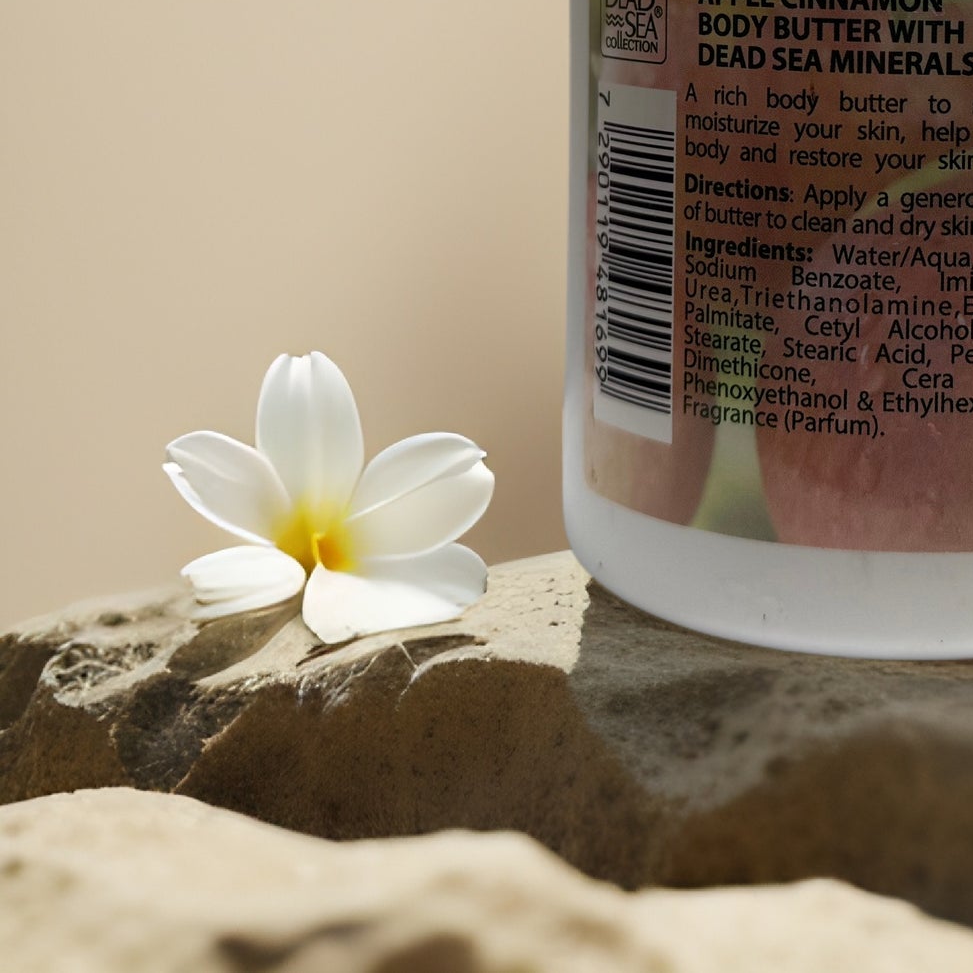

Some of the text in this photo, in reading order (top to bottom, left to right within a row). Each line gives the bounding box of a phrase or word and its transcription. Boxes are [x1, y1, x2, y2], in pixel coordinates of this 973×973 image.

[698, 12, 965, 45] BODY BUTTER WITH
[698, 43, 766, 70] DEAD
[772, 47, 823, 73] SEA
[685, 82, 698, 103] A
[714, 85, 748, 107] rich
[766, 87, 819, 116] body
[839, 90, 908, 113] butter
[928, 95, 951, 114] to
[685, 112, 780, 136] moisturize
[794, 122, 842, 143] your
[857, 119, 905, 144] skin,
[922, 120, 970, 147] help
[685, 135, 730, 165] body
[740, 142, 777, 164] and
[789, 147, 863, 168] restore
[875, 152, 926, 174] your
[684, 173, 794, 203] Directions:
[804, 183, 867, 212] Apply
[877, 191, 889, 207] a
[684, 201, 702, 221] of
[705, 202, 762, 228] butter
[766, 211, 787, 230] to
[792, 211, 846, 234] clean
[852, 214, 894, 236] and
[900, 214, 936, 241] dry
[685, 231, 813, 262] Ingredients:
[685, 254, 756, 282] Sodium
[792, 266, 901, 294] Benzoate,
[685, 302, 779, 334] Palmitate,
[804, 315, 860, 343] Cetyl
[684, 325, 766, 357] Stearate,
[783, 337, 857, 362] Stearic
[875, 343, 931, 367] Acid,
[684, 348, 816, 386] Dimethicone,
[902, 368, 954, 389] Cera
[684, 371, 848, 410] Phenoxyethanol
[857, 390, 874, 412] &
[683, 395, 885, 439] Fragrance (Parfum).
